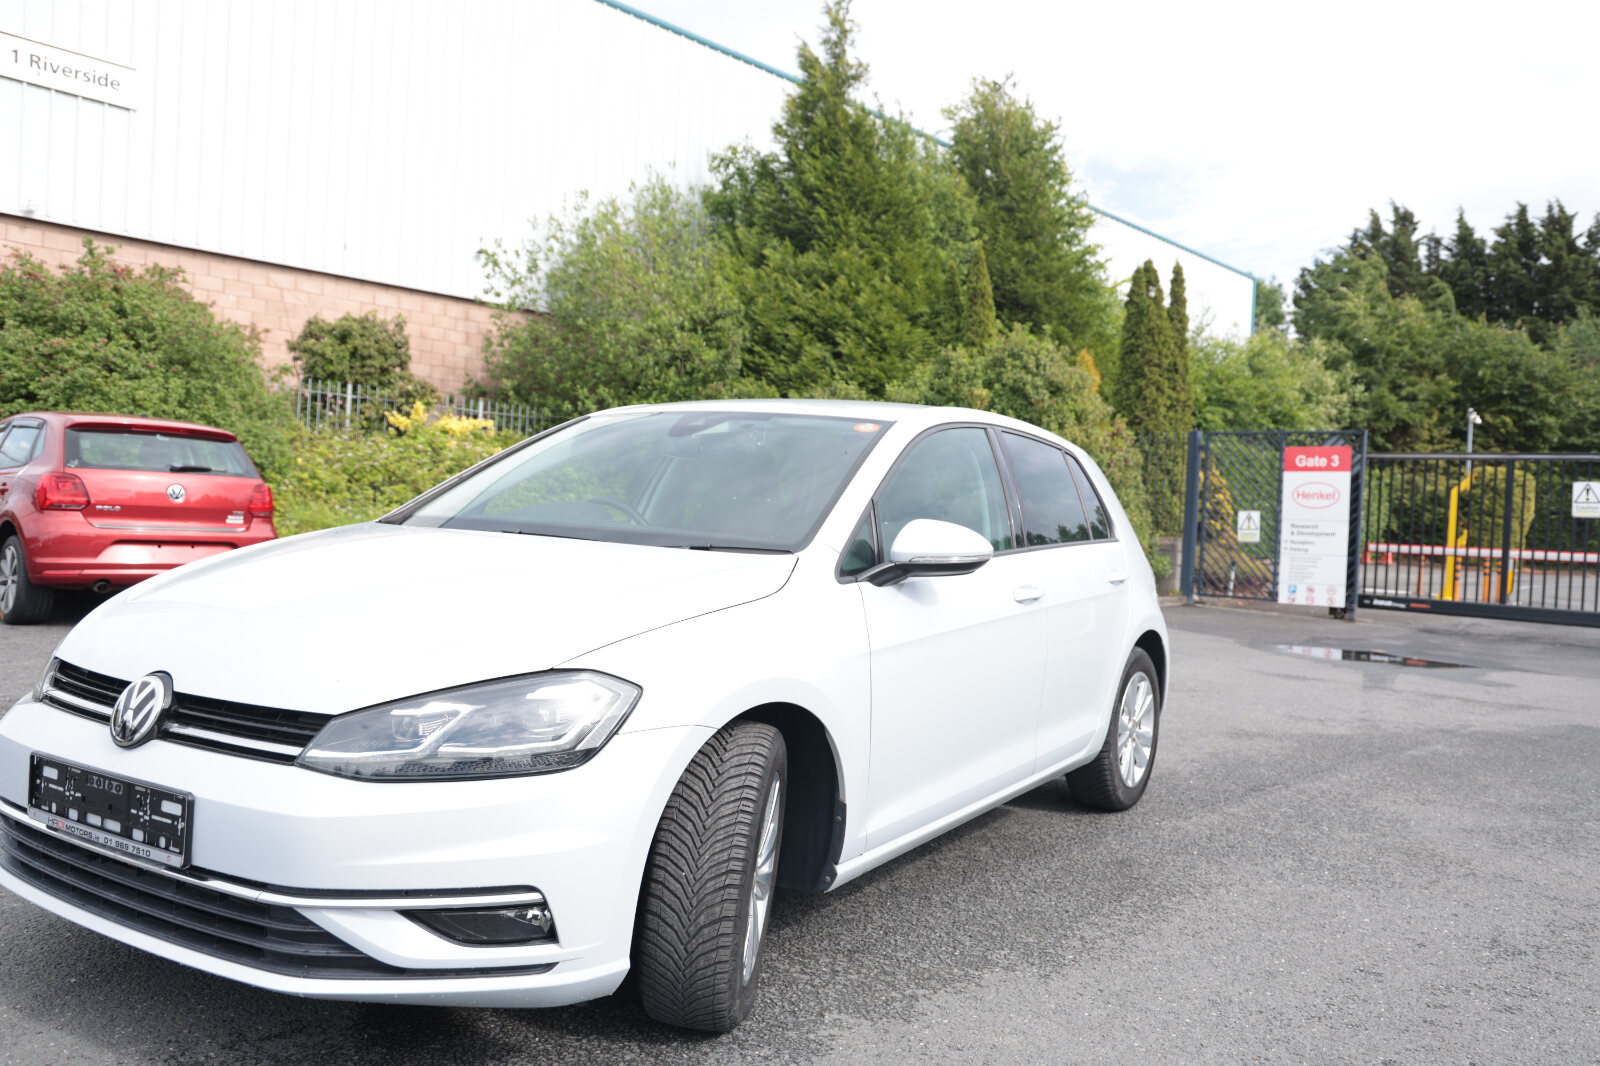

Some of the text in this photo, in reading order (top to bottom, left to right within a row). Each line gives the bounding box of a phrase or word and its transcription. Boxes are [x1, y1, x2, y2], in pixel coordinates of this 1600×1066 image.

[11, 48, 121, 91] 1 Riverside
[1295, 454, 1340, 468] Gate 3
[1296, 489, 1336, 501] Henkel
[131, 845, 151, 857] 7510
